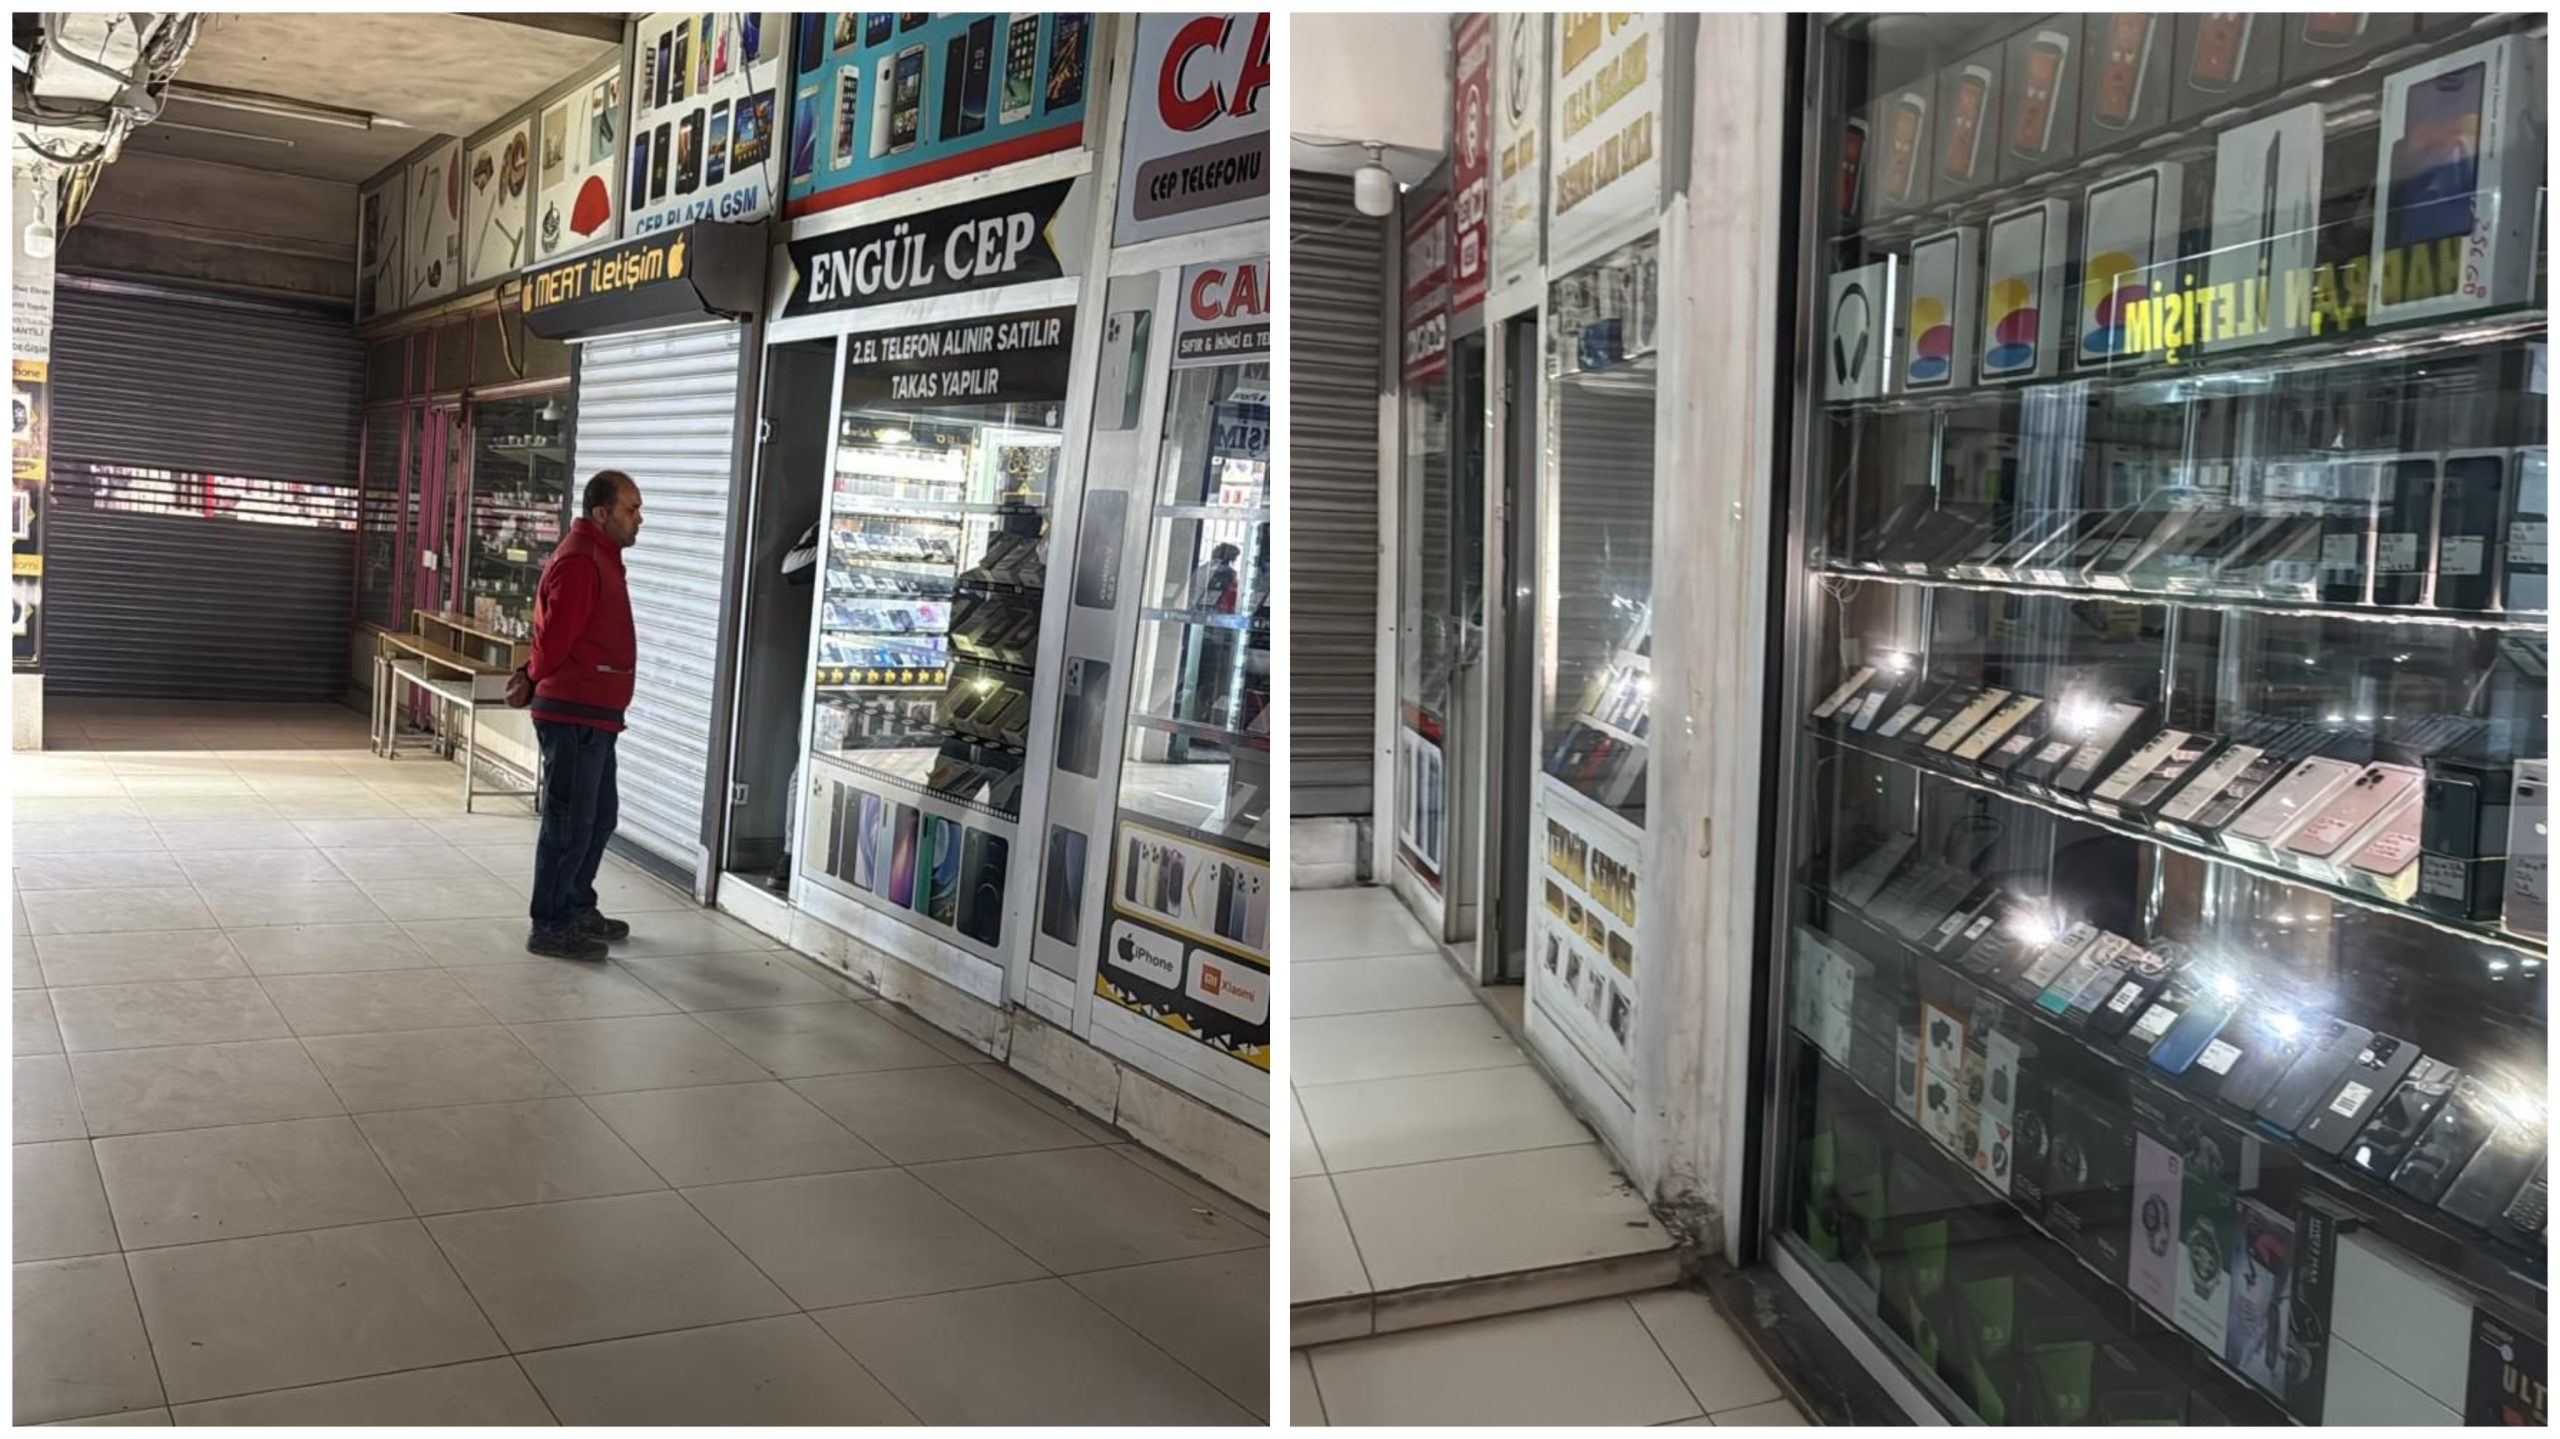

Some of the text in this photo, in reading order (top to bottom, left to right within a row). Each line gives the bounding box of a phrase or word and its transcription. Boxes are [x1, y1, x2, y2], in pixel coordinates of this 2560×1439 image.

[1150, 151, 1262, 200] CEP TELEFONU
[720, 185, 758, 218] GSM
[808, 211, 1035, 303] ENGÜL CEP
[851, 318, 1061, 365] 2.EL TELEFON ALINIR SATILIR
[891, 368, 999, 400] TAKAS YAPILIR
[1135, 946, 1174, 973] iPhone
[1221, 980, 1255, 1002] Xiaomi
